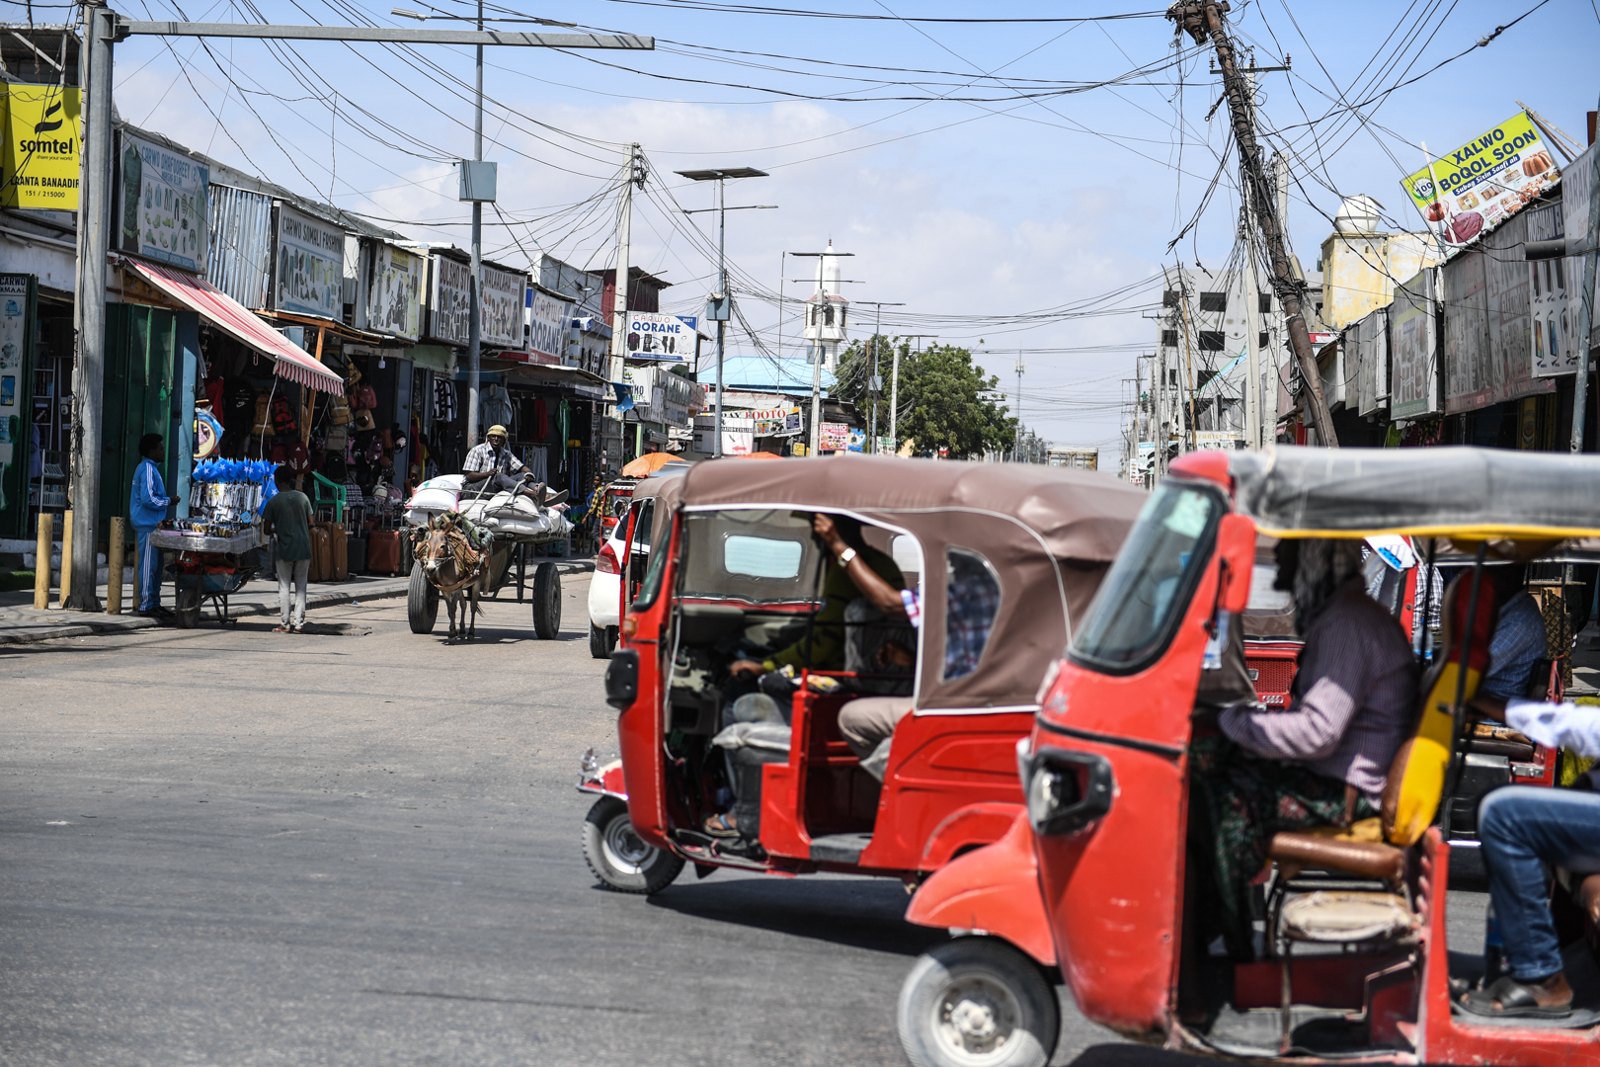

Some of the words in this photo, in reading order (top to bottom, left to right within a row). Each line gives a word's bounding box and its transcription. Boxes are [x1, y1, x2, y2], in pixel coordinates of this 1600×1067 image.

[20, 138, 73, 154] somtel
[1452, 128, 1505, 165] XALWO
[1438, 156, 1492, 192] BOQOL
[1493, 129, 1537, 160] SOON
[11, 176, 39, 187] LAANTA
[282, 215, 302, 240] CARWO
[303, 224, 322, 247] SOMALI
[0, 277, 26, 286] CARWO
[534, 296, 563, 324] CARWO
[633, 314, 671, 323] CARWO
[530, 319, 561, 354] QORANE
[632, 321, 681, 333] QORANE
